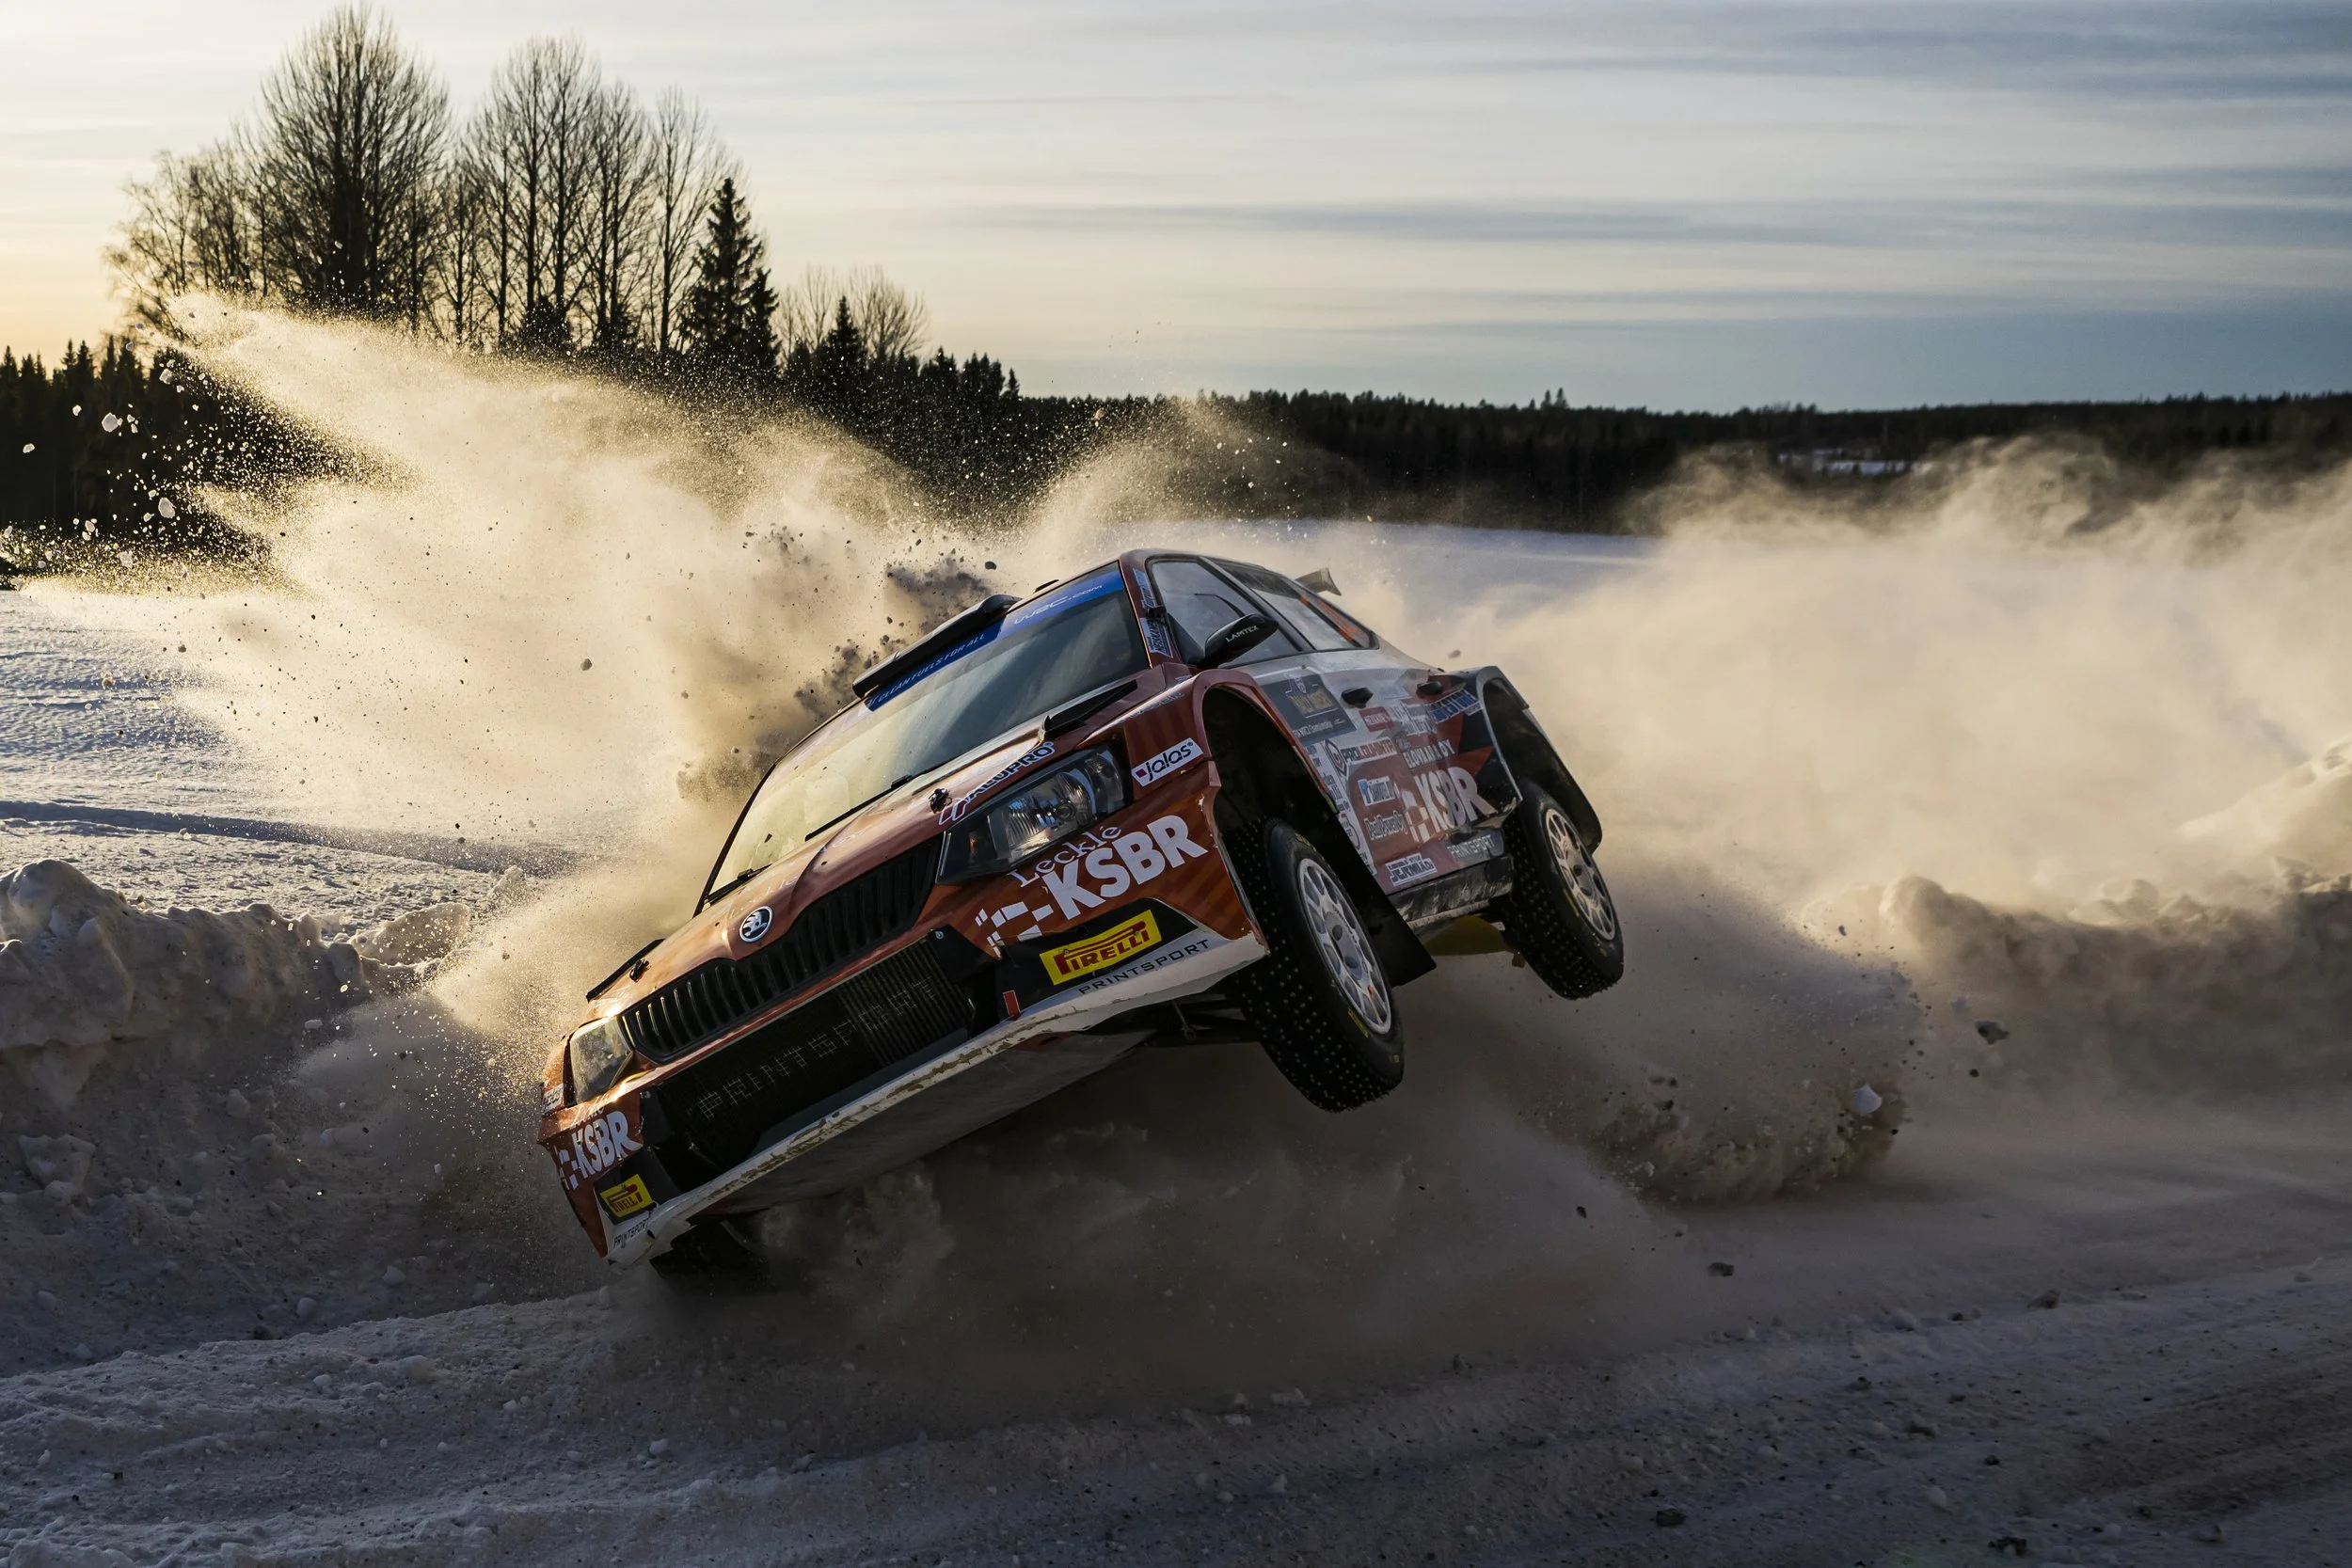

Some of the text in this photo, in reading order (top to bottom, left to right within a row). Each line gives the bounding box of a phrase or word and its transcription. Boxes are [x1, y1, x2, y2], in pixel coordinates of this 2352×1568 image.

[1225, 625, 1260, 642] LAMTEX
[878, 633, 985, 703] CLEAN FUELS FOR ALL
[1146, 744, 1192, 782] jalas
[1414, 768, 1497, 832] KSBR
[1041, 815, 1208, 921] KSBR
[1053, 921, 1151, 974] PIRELLI
[1079, 939, 1210, 994] PRINTSPORT
[571, 1110, 644, 1179] KSBR
